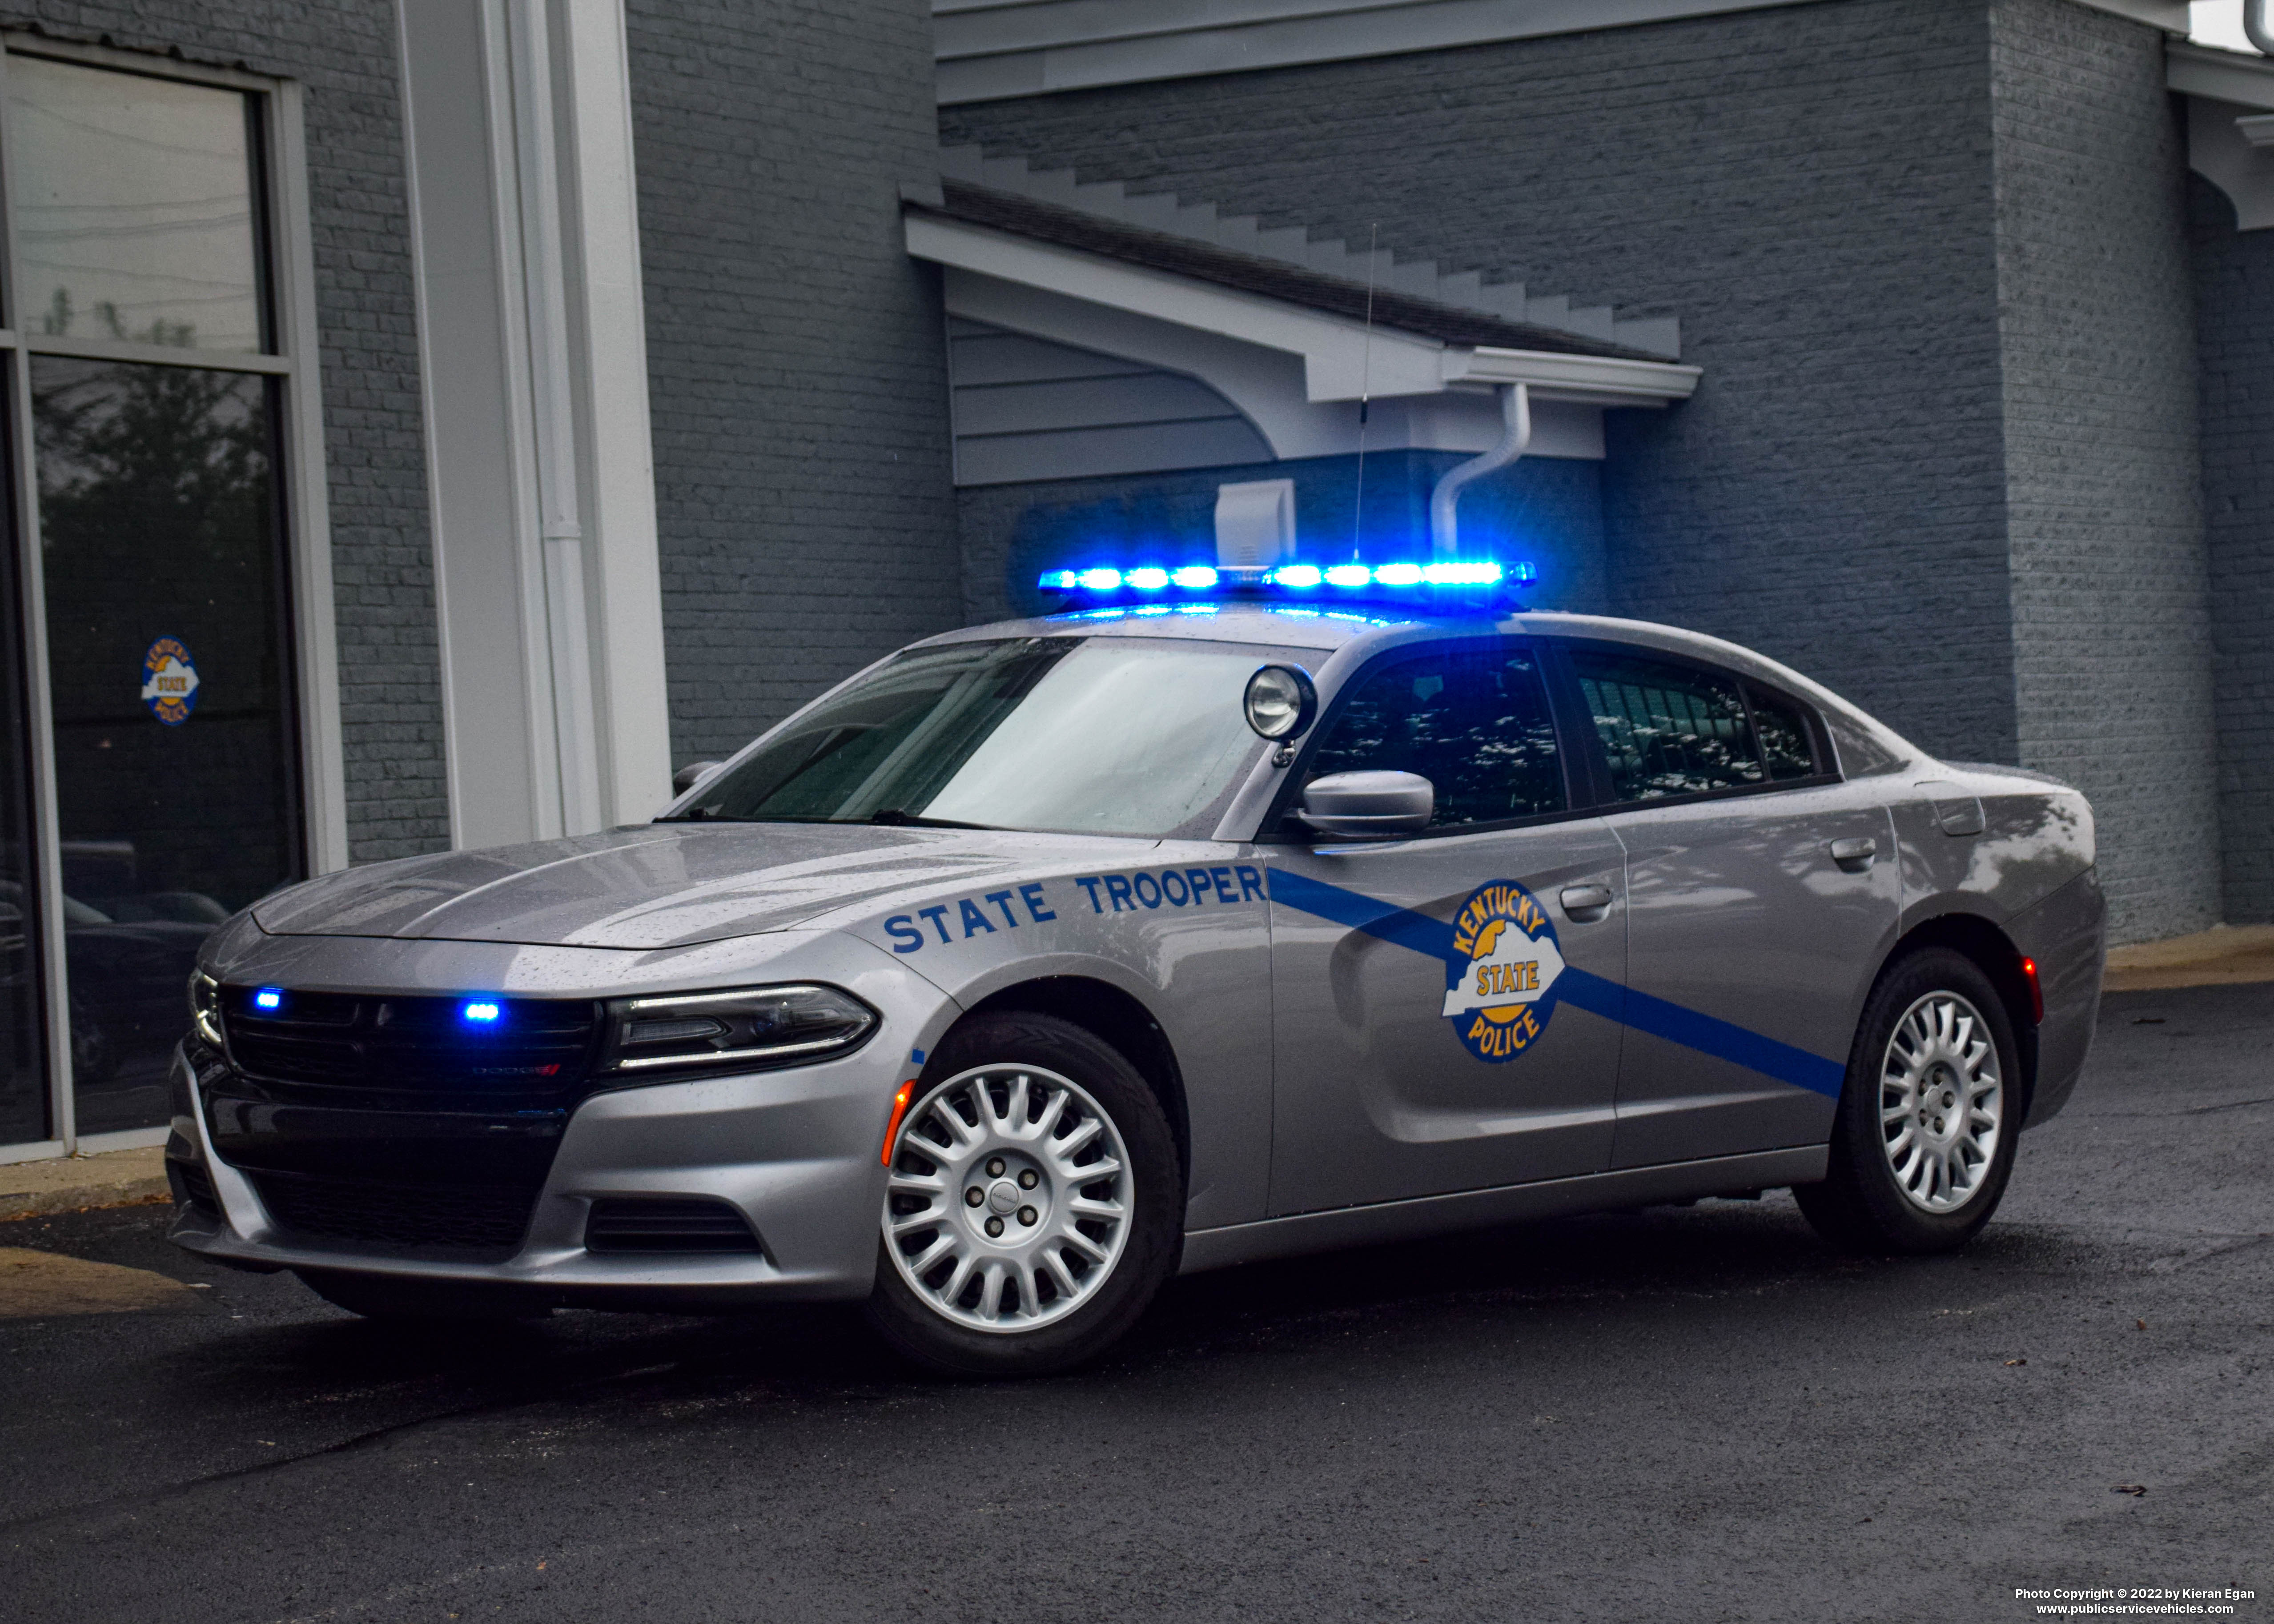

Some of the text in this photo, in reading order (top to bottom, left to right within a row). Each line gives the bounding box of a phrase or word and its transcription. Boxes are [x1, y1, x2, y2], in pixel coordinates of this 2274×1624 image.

[157, 676, 187, 691] STATE
[155, 701, 188, 722] POLICE
[884, 865, 1267, 953] STATE TROOPER
[1454, 886, 1545, 954] KENTUCKY
[1477, 960, 1539, 996] STATE
[1468, 1010, 1540, 1056] POLICE
